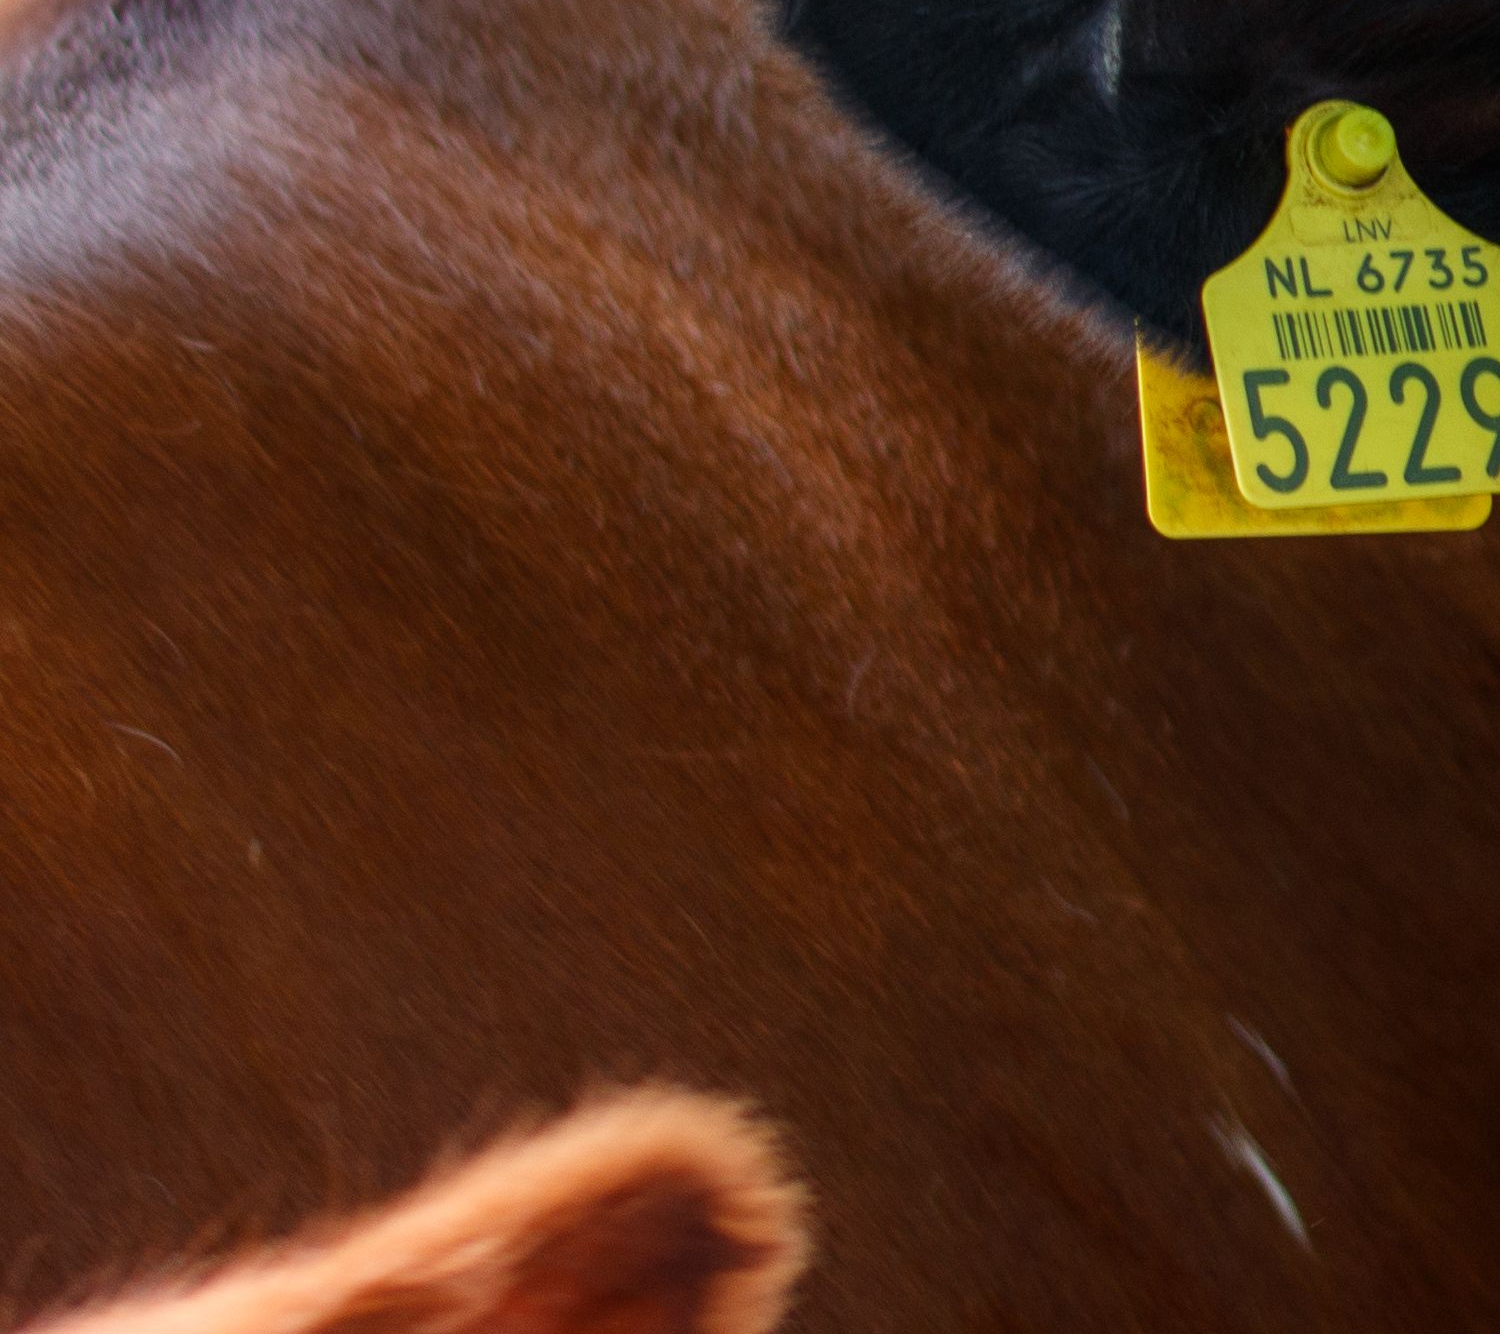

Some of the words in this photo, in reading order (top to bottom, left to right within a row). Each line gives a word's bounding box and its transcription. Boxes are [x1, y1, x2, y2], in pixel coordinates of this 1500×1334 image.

[1343, 218, 1392, 244] LNV
[1264, 256, 1333, 299] NL
[1356, 246, 1488, 294] 6735
